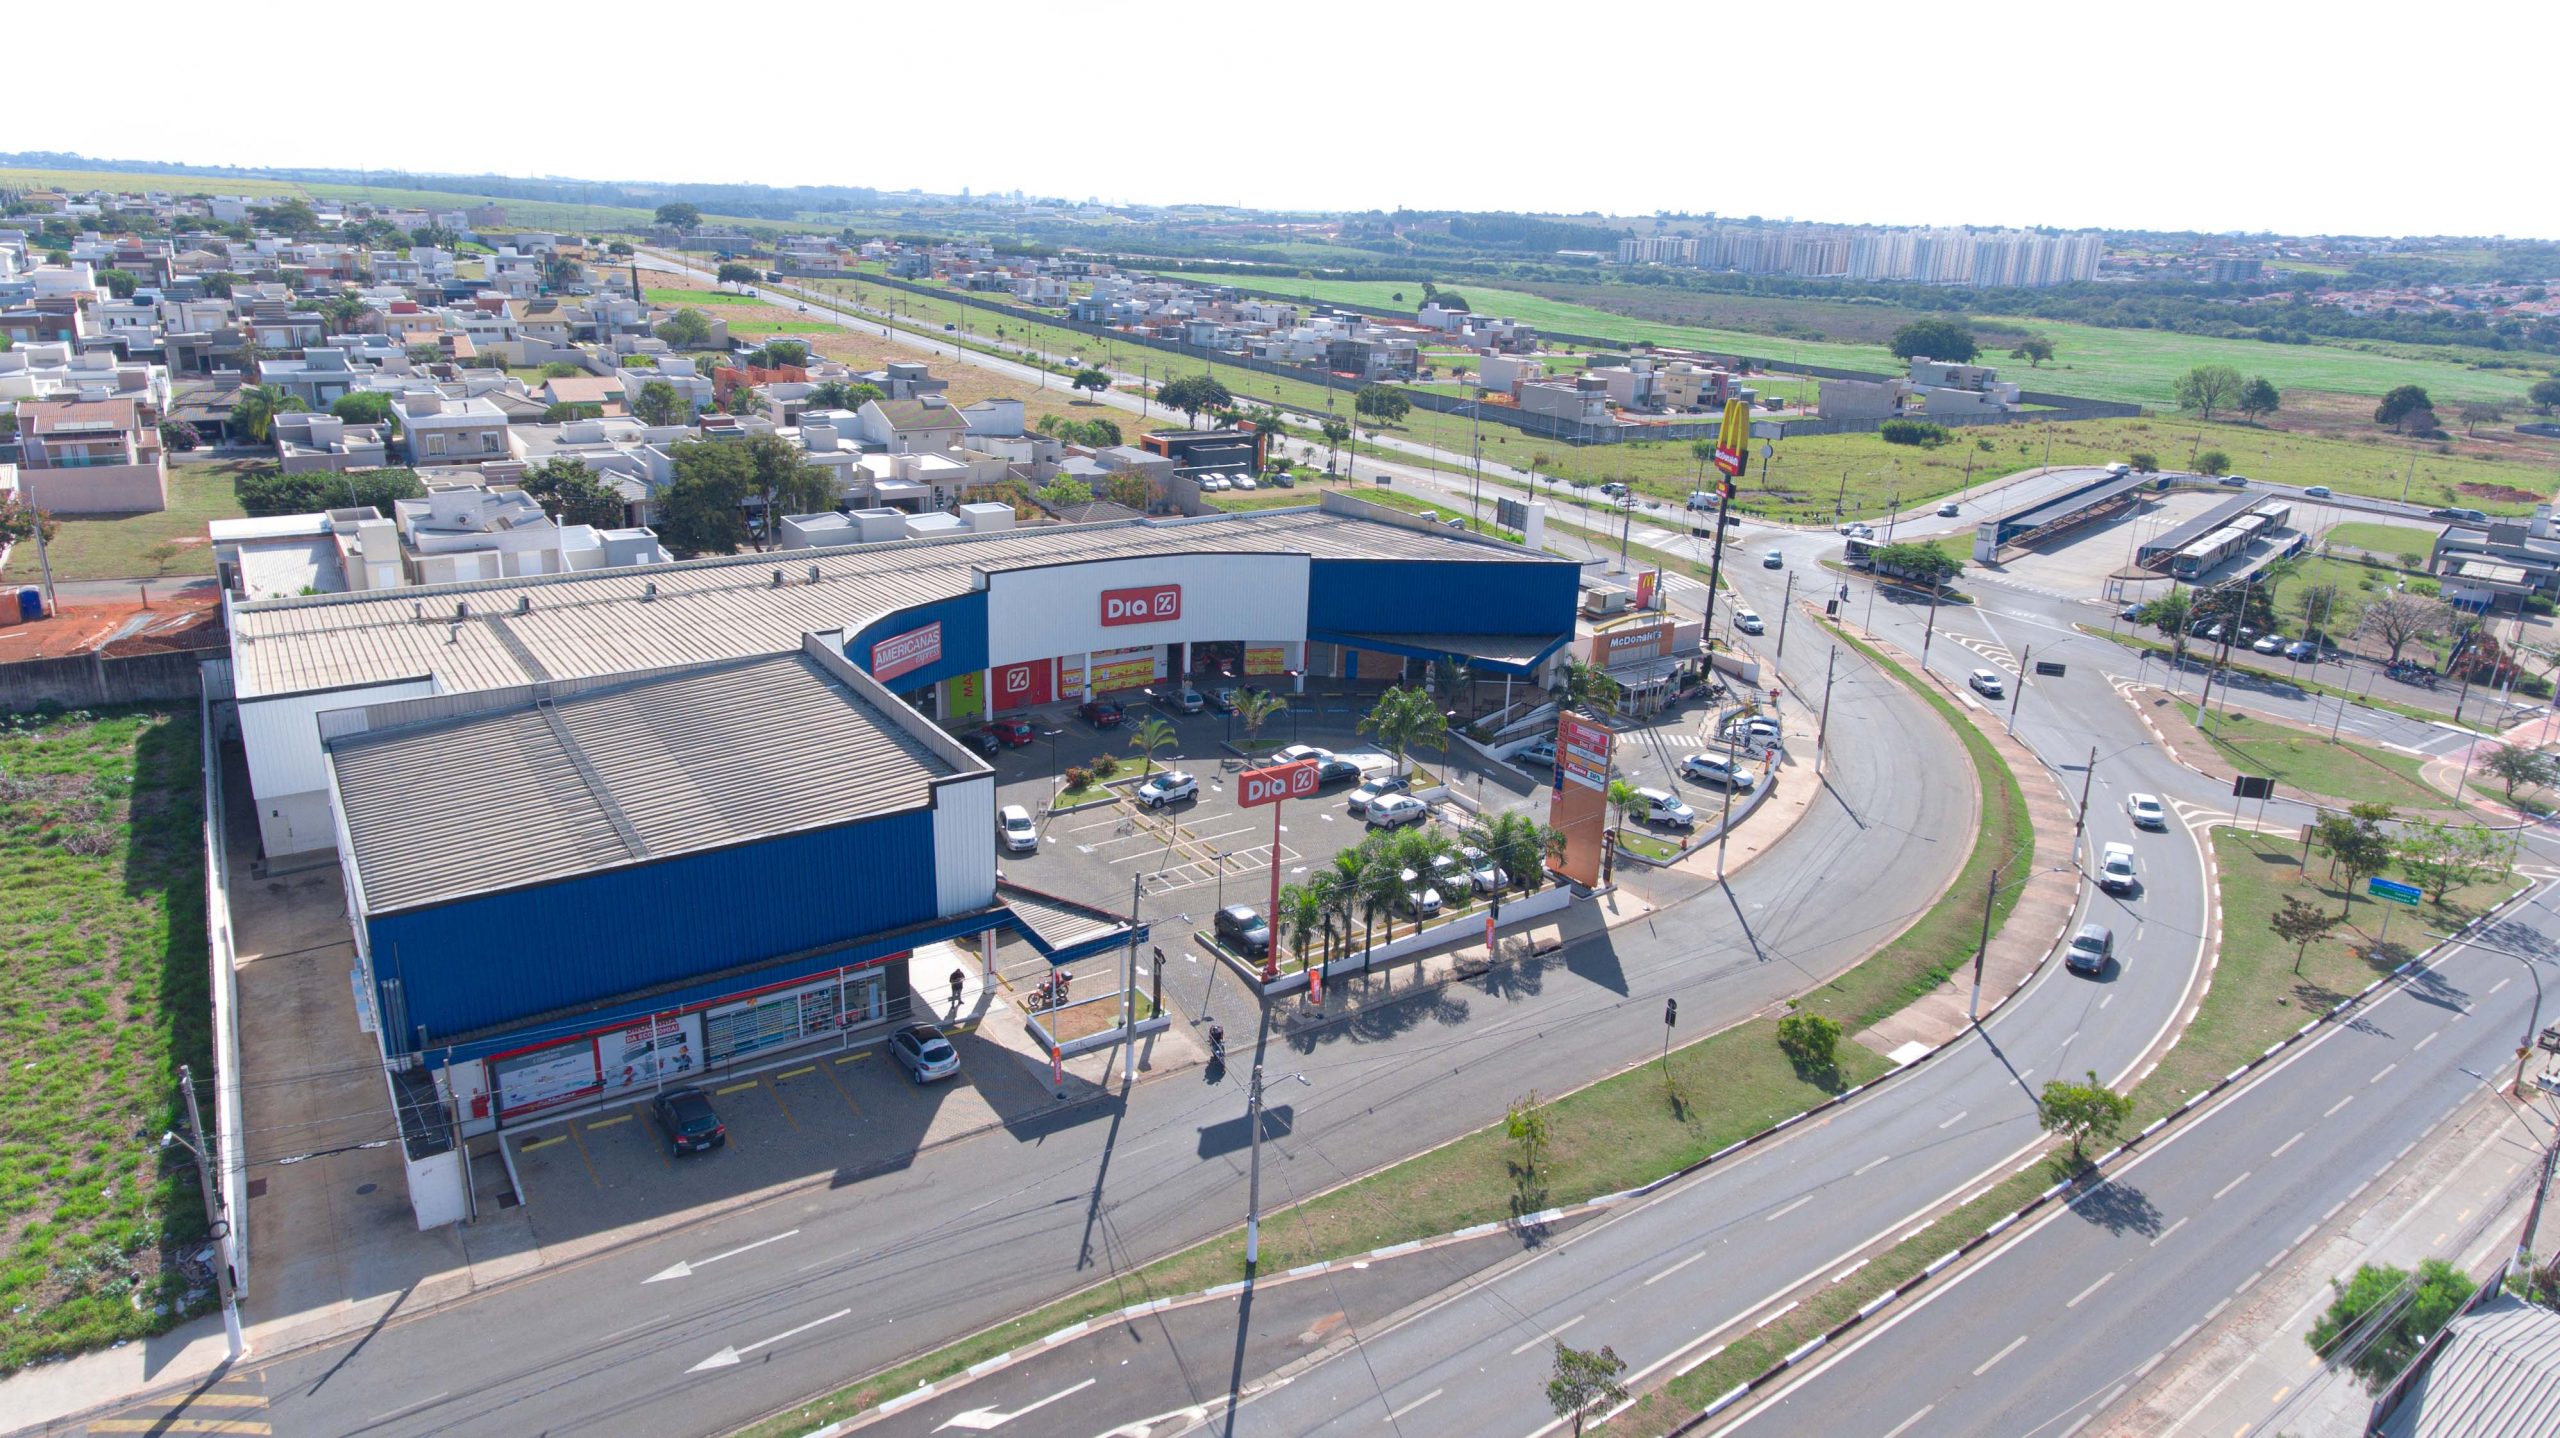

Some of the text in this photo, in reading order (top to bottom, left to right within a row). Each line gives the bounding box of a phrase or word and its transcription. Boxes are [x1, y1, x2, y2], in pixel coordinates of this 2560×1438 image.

[1108, 599, 1148, 618] Dia
[875, 630, 940, 667] AMERICANAS
[1610, 631, 1663, 648] McDonald's
[915, 647, 940, 665] express
[1248, 779, 1286, 800] Dia
[638, 1024, 679, 1040] ECOOMIA!
